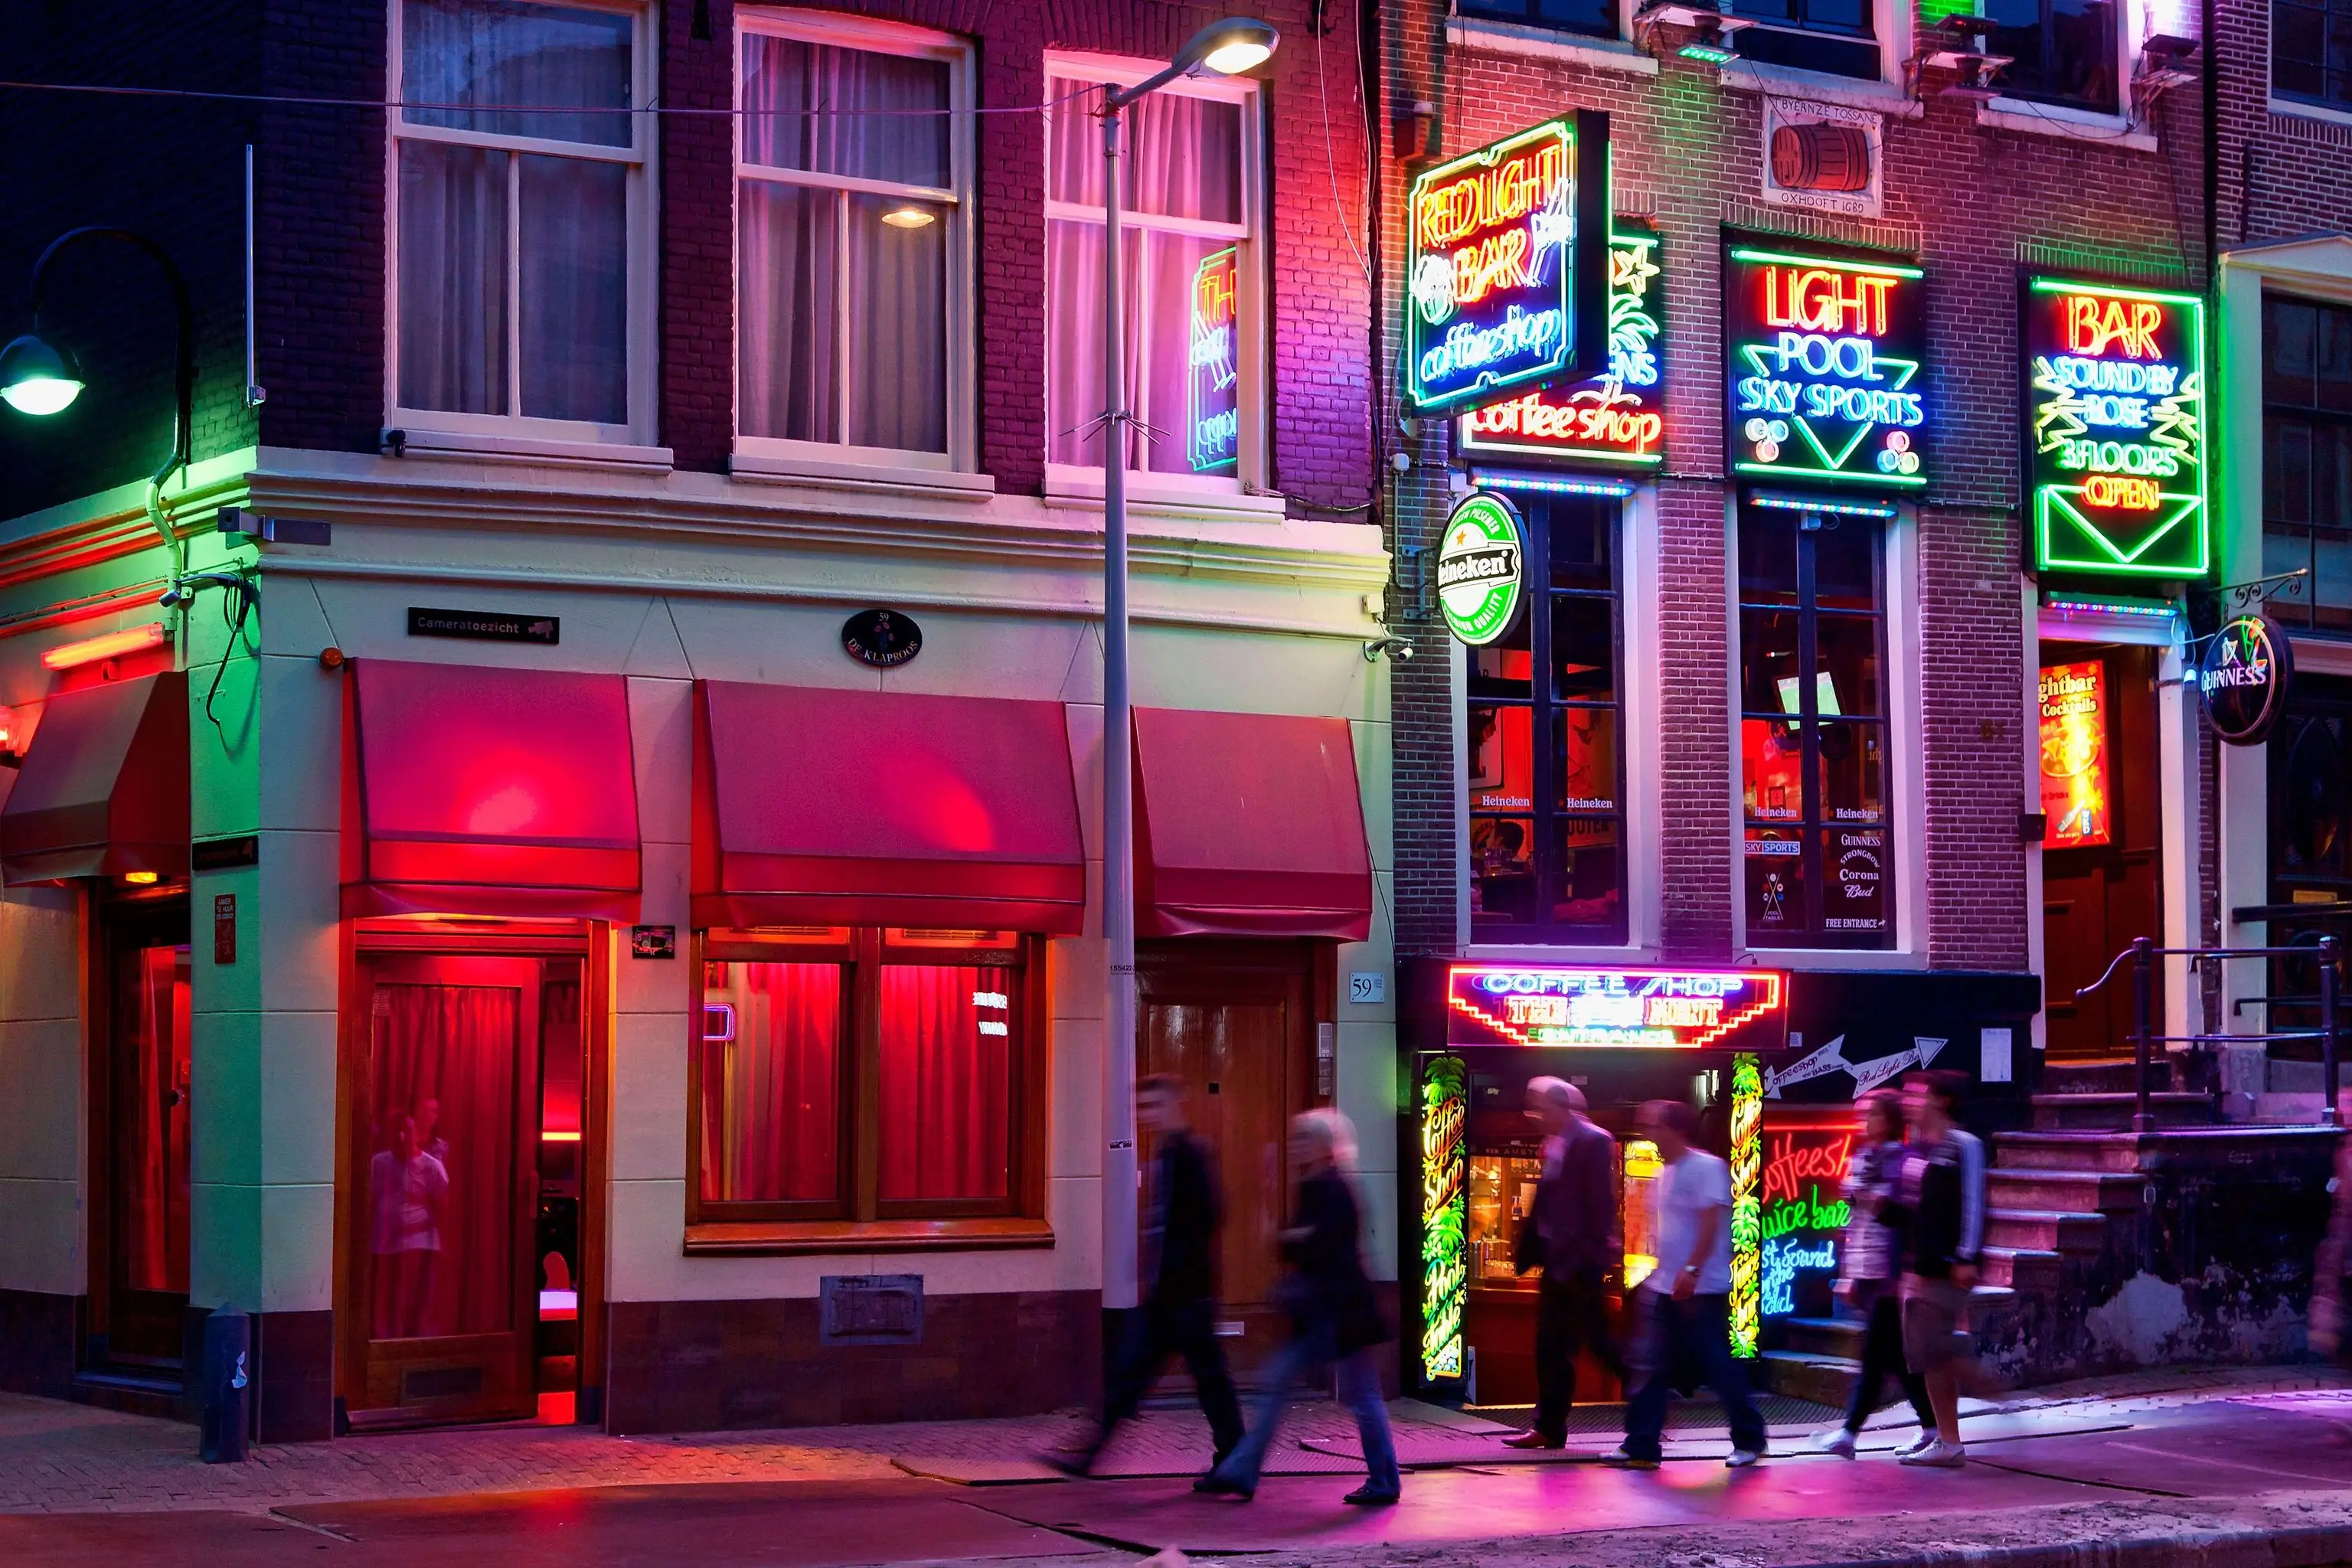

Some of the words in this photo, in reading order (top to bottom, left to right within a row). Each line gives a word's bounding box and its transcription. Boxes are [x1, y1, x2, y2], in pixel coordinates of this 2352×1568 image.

[1781, 192, 1838, 210] OXHOOFT
[1454, 227, 1527, 301] BAR
[1766, 266, 1898, 337] LIGHT
[2067, 296, 2161, 360] BAR
[1778, 331, 1884, 381] POOL
[2054, 356, 2145, 393] SOUND
[1737, 376, 1802, 413] SKY
[1803, 382, 1924, 427] SPORTS
[2082, 394, 2149, 428] BOSE
[2077, 439, 2179, 476] FLOORS
[2082, 475, 2161, 511] OPEN
[878, 612, 890, 622] 59
[1473, 592, 1503, 630] QUALITY
[417, 616, 519, 634] Cameratoezicht
[2201, 665, 2267, 692] GUINNESS
[1482, 795, 1530, 807] Heineken
[1567, 797, 1613, 808] Heineken
[1754, 806, 1798, 818] Heineken
[1837, 808, 1879, 819] Heineken
[1746, 843, 1761, 852] SKY
[1764, 844, 1798, 853] SPORTS
[1841, 834, 1881, 847] GUINNESS
[1840, 849, 1880, 868] STRONGBOW
[1839, 868, 1880, 881] Corona
[1844, 884, 1875, 898] Bud
[1826, 918, 1842, 928] FREE
[1843, 919, 1877, 929] ENTRANCE
[1353, 978, 1372, 998] 59
[1483, 974, 1629, 995] COFFEE
[1858, 1069, 1877, 1086] Red
[1877, 1059, 1901, 1078] Light
[1424, 1097, 1464, 1167] Coffee
[1762, 1132, 1852, 1204] offeesh
[1424, 1156, 1463, 1214] Shop
[1762, 1197, 1808, 1240] uice
[1811, 1184, 1852, 1229] bar
